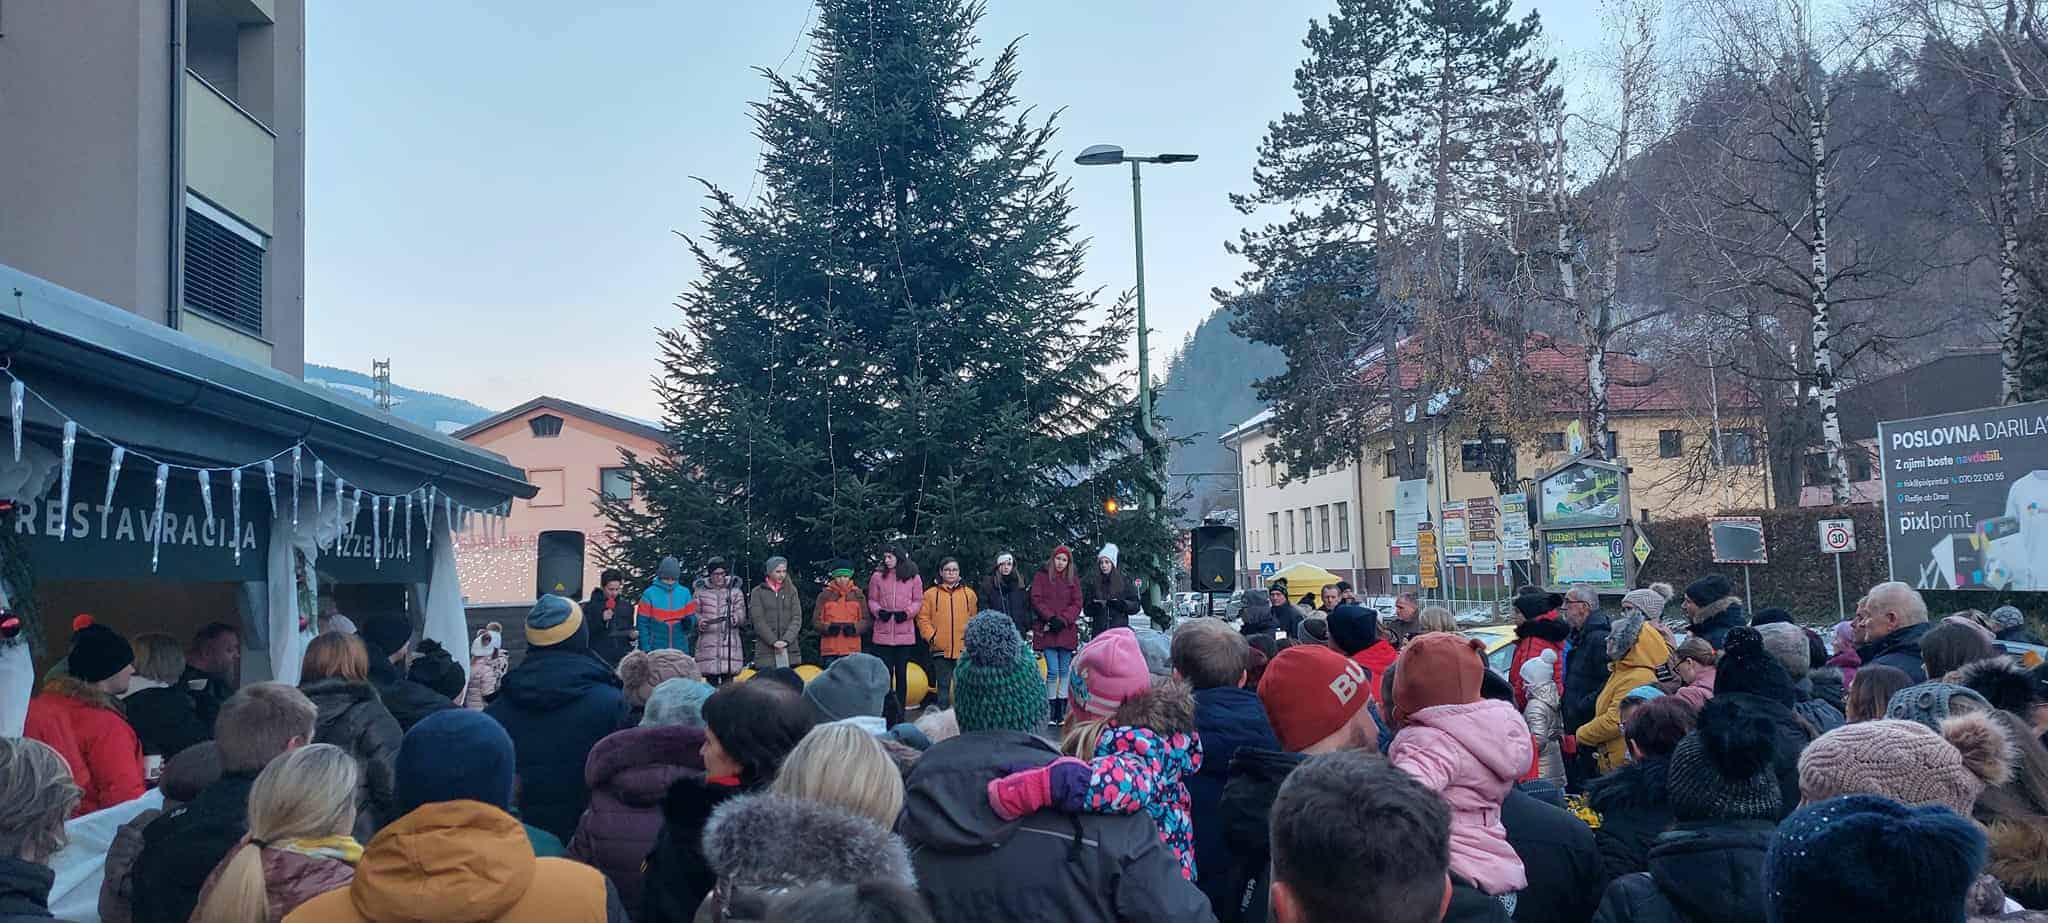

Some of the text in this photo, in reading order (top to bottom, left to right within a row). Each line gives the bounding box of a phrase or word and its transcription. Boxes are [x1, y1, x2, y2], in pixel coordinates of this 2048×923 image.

[1892, 423, 1981, 450] POSLOVNA
[1895, 459, 1903, 470] Z
[1903, 457, 1926, 472] njimi
[1927, 455, 1954, 467] boste
[15, 498, 257, 550] RESTAVRACIJA
[1899, 510, 1974, 535] pixlprint
[1831, 533, 1845, 544] 30
